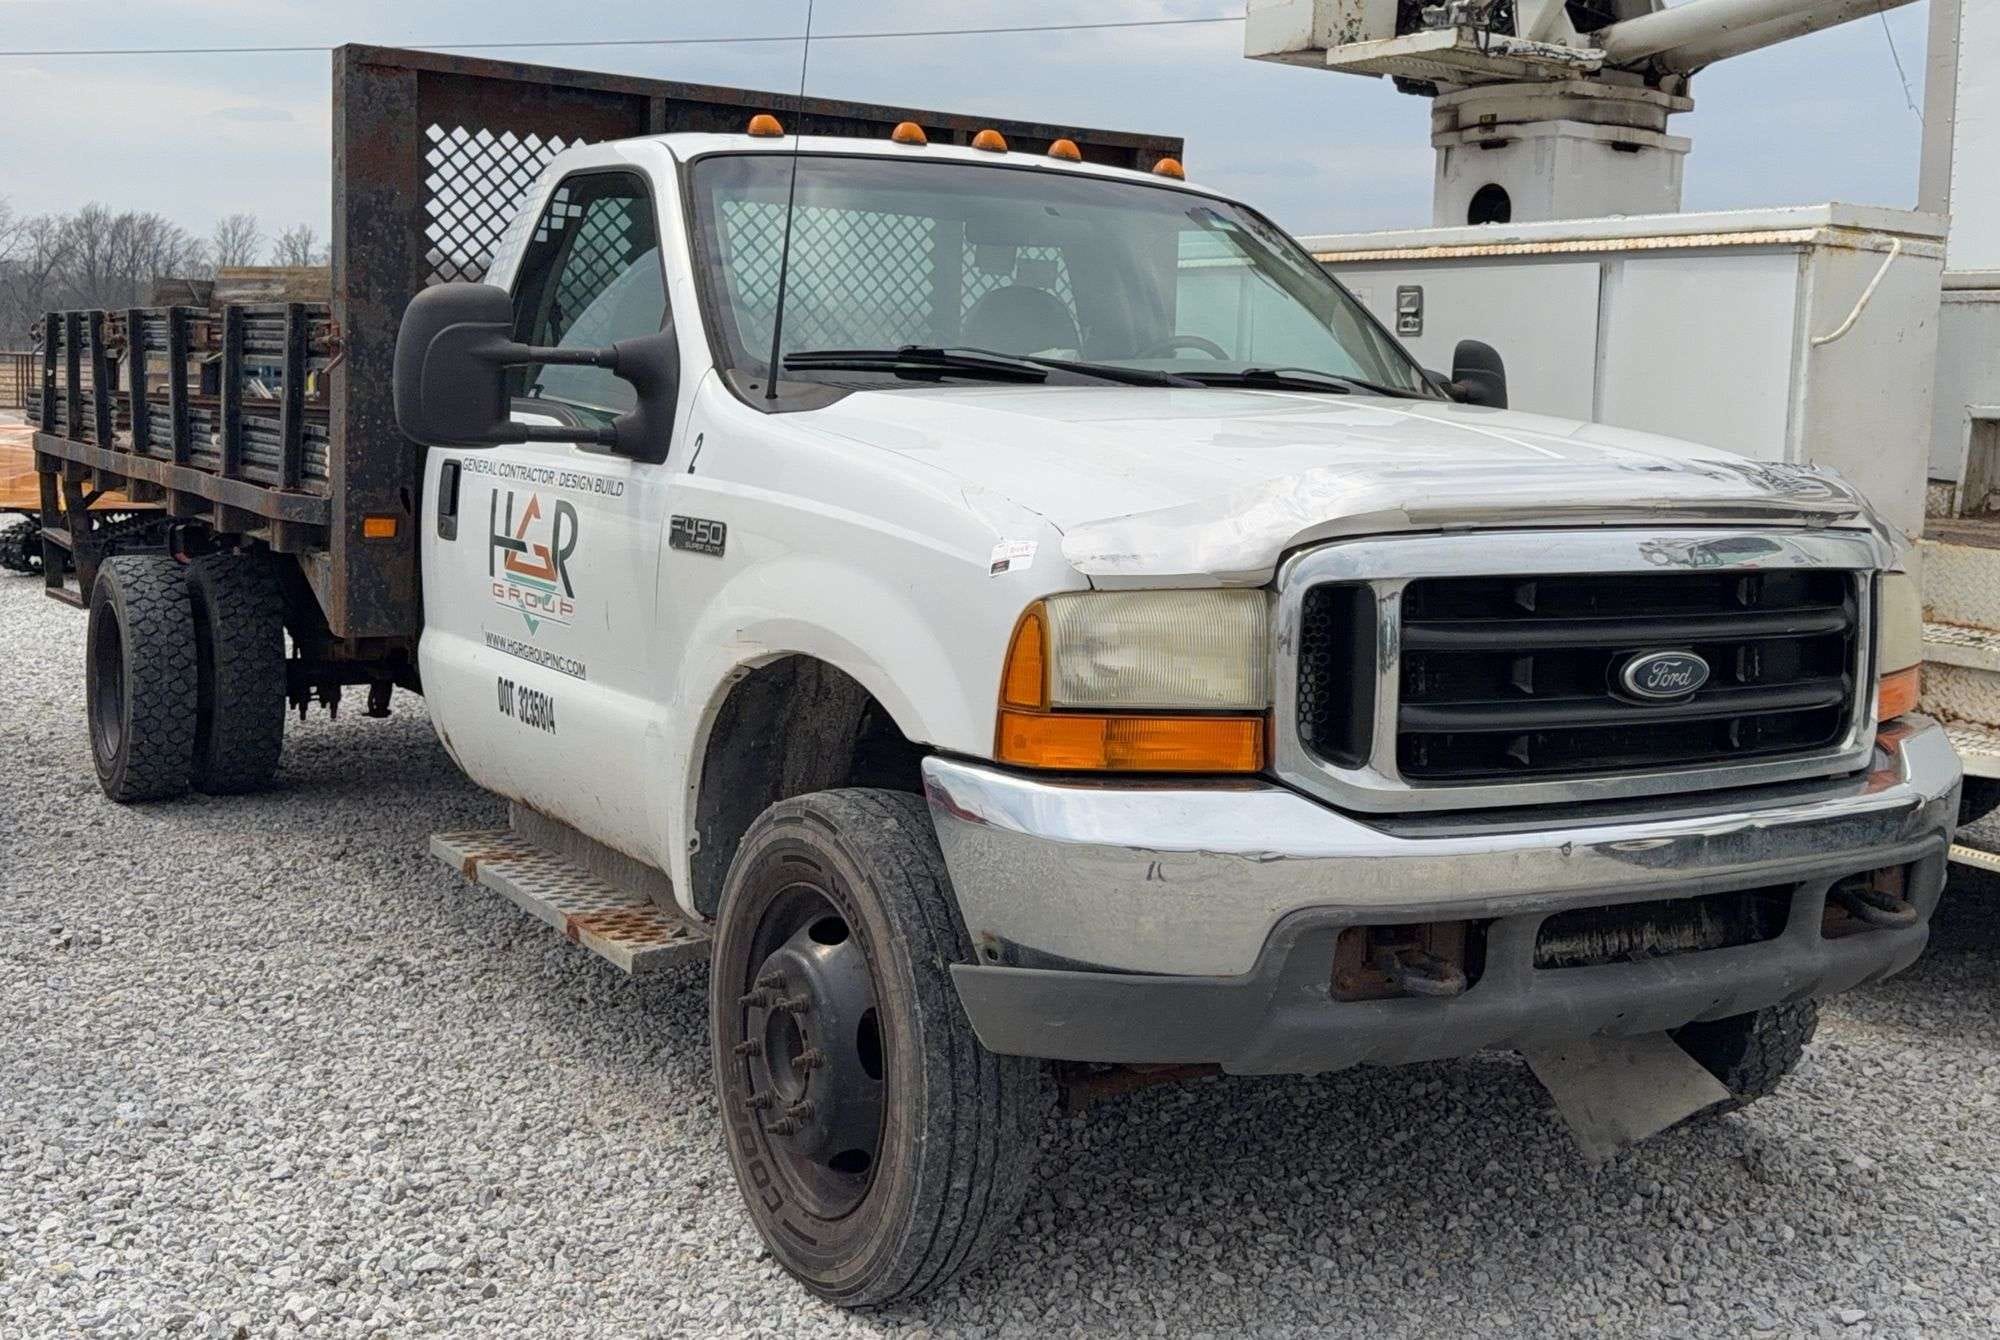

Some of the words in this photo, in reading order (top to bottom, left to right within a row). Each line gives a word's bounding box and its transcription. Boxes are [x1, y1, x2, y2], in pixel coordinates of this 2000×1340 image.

[687, 432, 704, 474] 2
[463, 457, 497, 476] GENERAL
[499, 462, 555, 485] CONTRACTOR
[558, 472, 593, 491] DESIGN
[595, 478, 624, 497] BUILD
[492, 583, 575, 615] GROUP
[485, 631, 586, 680] WWW.HGRGROUPINC.COM
[1647, 660, 1693, 688] Ford
[497, 676, 515, 718] DOT
[518, 685, 556, 735] 3235814
